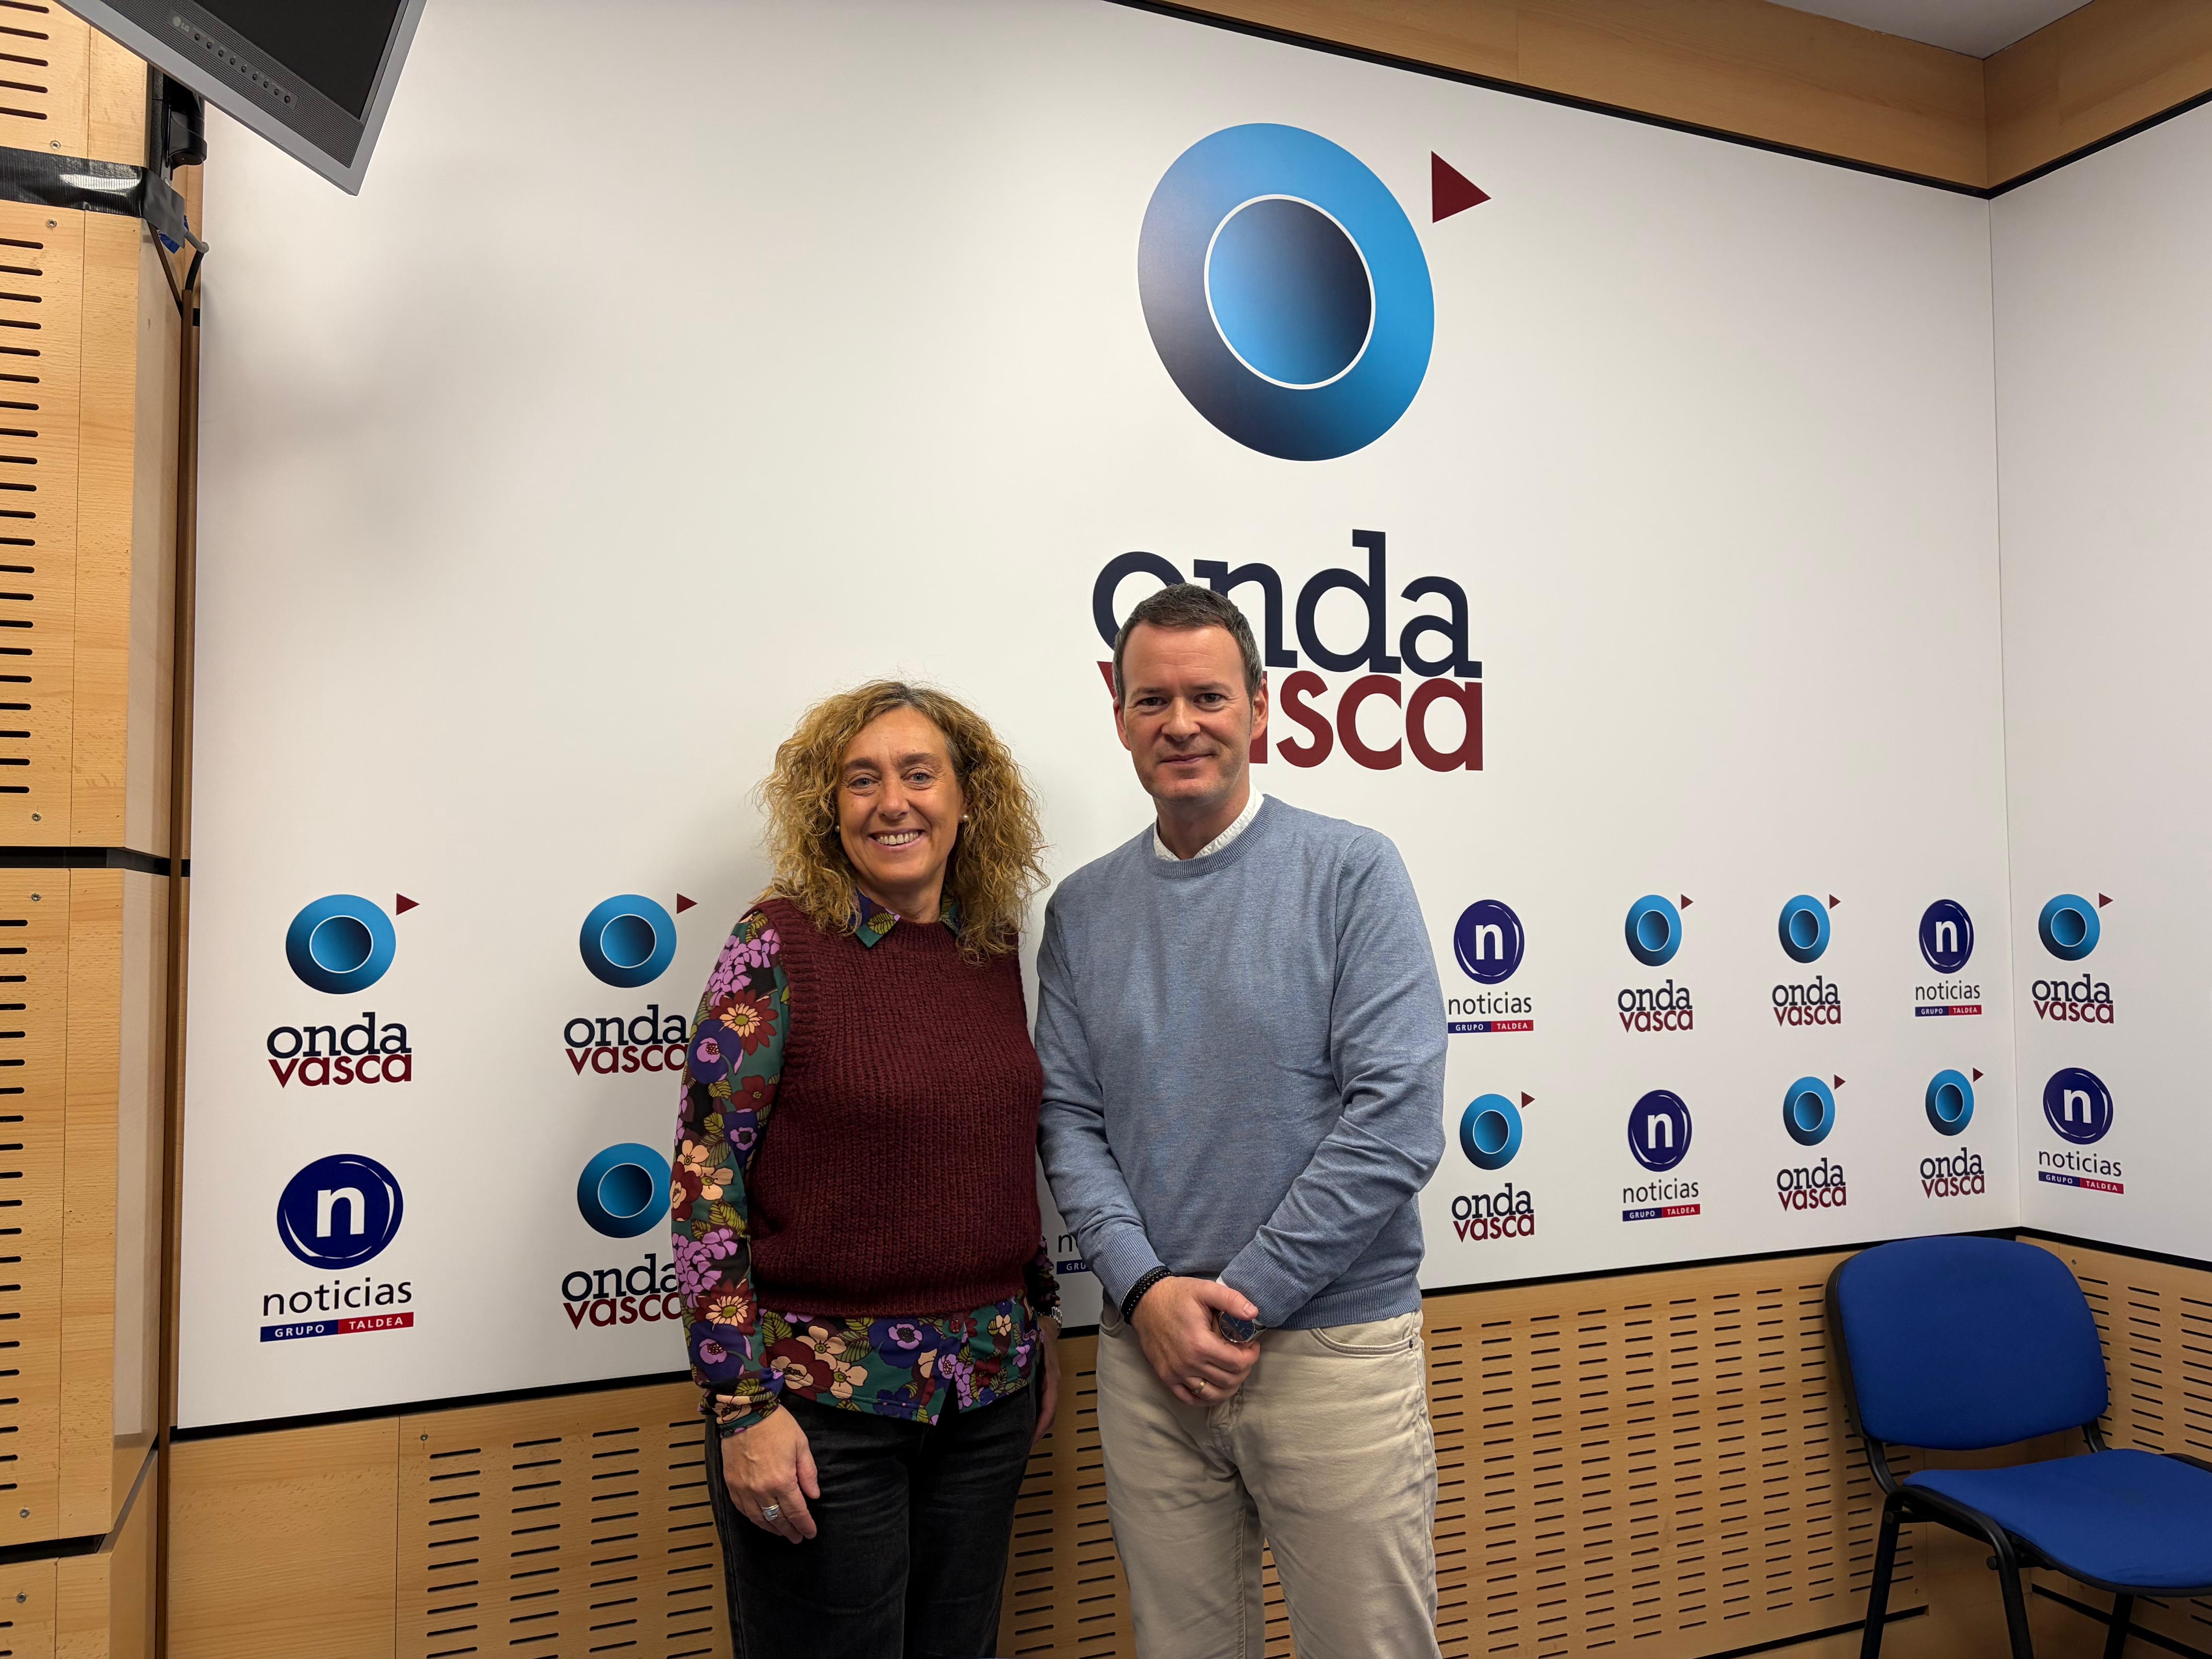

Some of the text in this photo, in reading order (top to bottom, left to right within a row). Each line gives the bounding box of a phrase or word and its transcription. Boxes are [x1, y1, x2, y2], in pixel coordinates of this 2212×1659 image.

[181, 22, 189, 32] LG
[1096, 661, 1483, 772] sca
[1475, 924, 1503, 960] n
[1936, 921, 1958, 953] n
[1448, 992, 1532, 1015] noticias
[1618, 979, 1693, 1012] onda
[1772, 975, 1841, 1007] onda
[1916, 980, 1980, 1001] noticias
[2032, 973, 2113, 1004] onda
[564, 1004, 690, 1048] onda
[1619, 1009, 1693, 1033] vasca
[1773, 1005, 1841, 1027] vasca
[2033, 1000, 2114, 1024] vasca
[267, 1011, 412, 1059] onda
[268, 1054, 412, 1088] vasca
[565, 1044, 688, 1076] vasca
[2063, 1089, 2091, 1124] n
[1647, 1113, 1673, 1149] n
[1777, 1157, 1846, 1192] onda
[1920, 1147, 1984, 1181] onda
[2038, 1151, 2122, 1177] noticias
[1623, 1178, 1699, 1204] noticias
[1921, 1174, 1985, 1199] vasca
[2046, 1174, 2118, 1191] GRUPO TALDEA
[316, 1187, 365, 1238] n
[1451, 1182, 1534, 1220] onda
[1629, 1206, 1695, 1219] GRUPO TALDEA
[1778, 1186, 1847, 1212] vasca
[1453, 1214, 1535, 1243] vasca
[1066, 1262, 1086, 1271] GRU
[263, 1277, 412, 1316] noticias
[275, 1316, 403, 1337] GRUPO TALDEA
